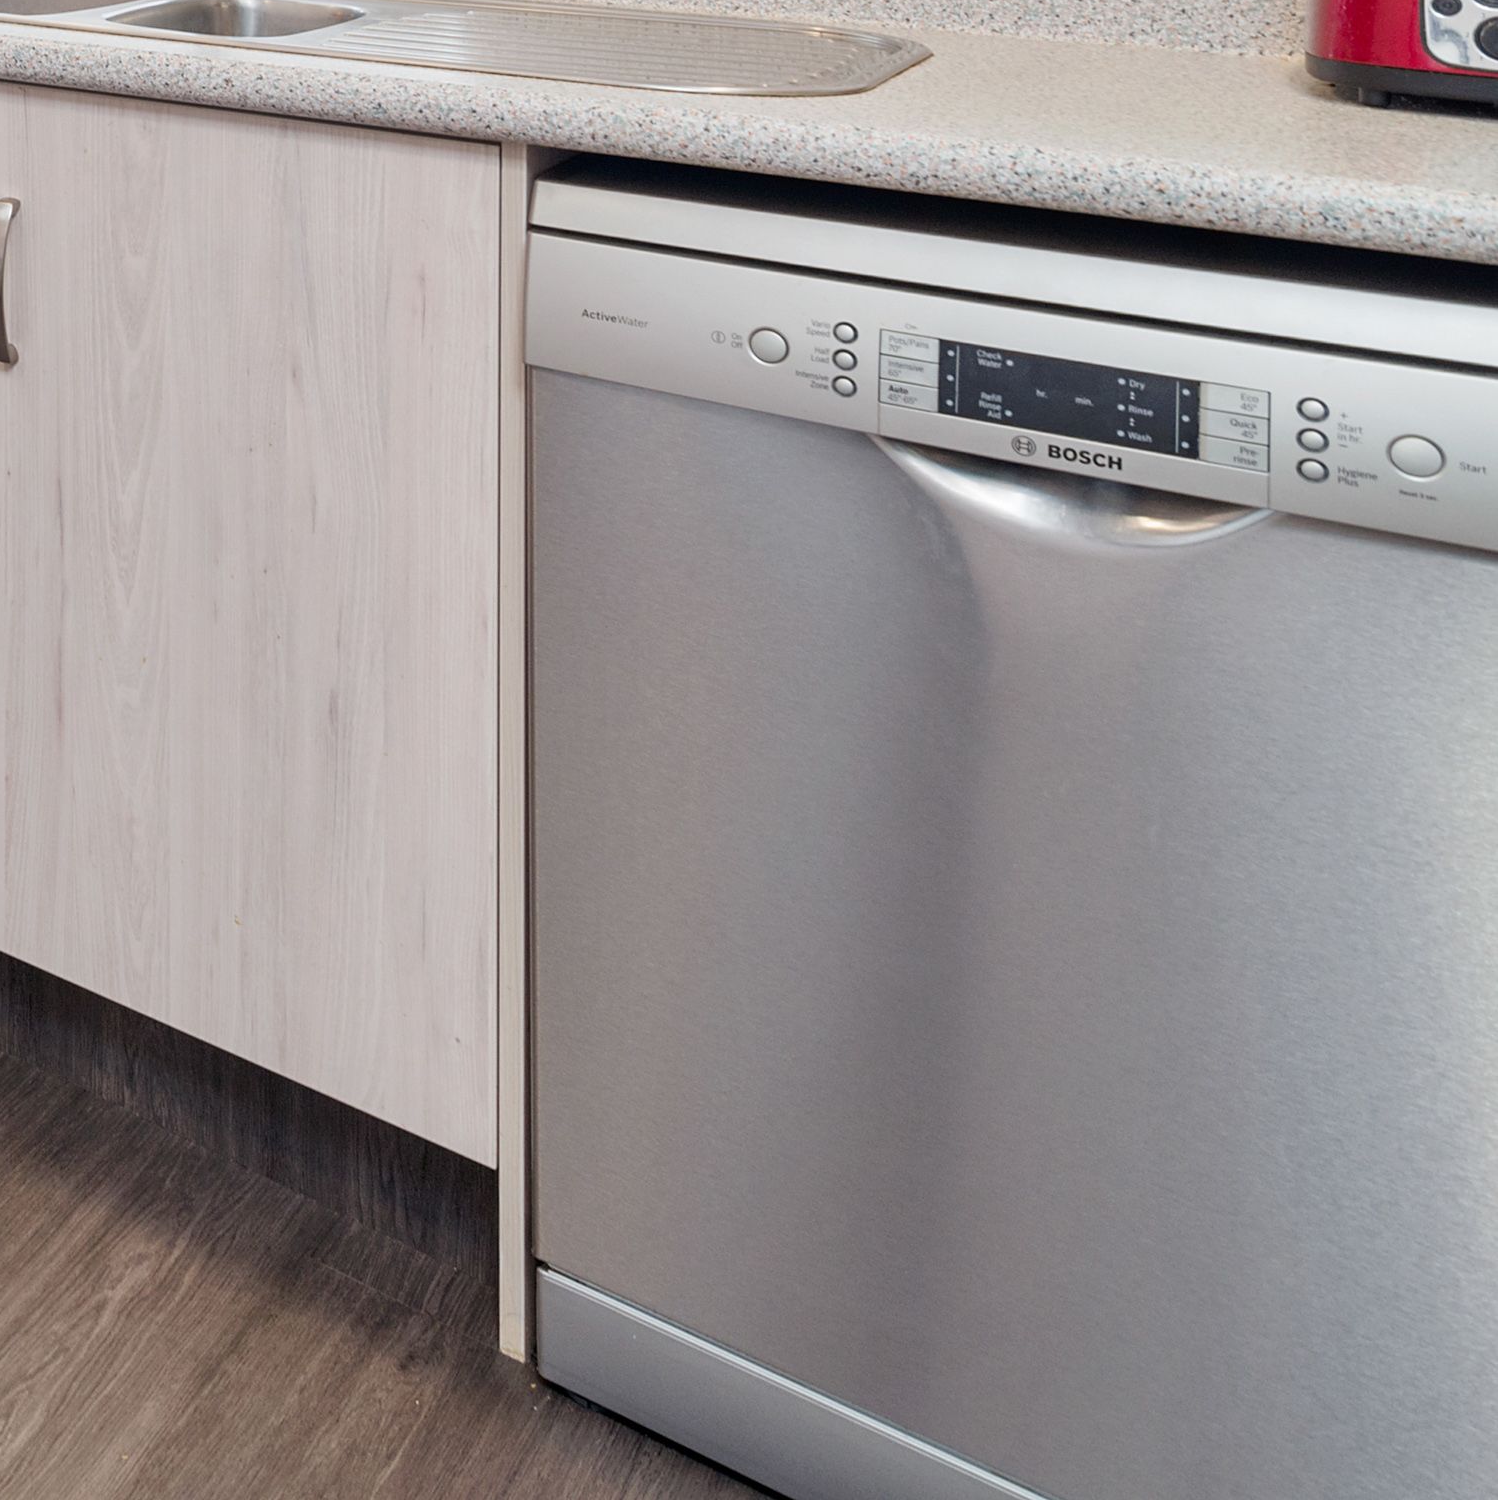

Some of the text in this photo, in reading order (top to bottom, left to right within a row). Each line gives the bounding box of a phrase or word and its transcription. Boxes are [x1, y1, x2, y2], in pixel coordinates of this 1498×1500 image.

[581, 308, 649, 329] ActiveWater
[731, 332, 742, 340] On
[976, 350, 1002, 361] Check
[978, 358, 1002, 369] Water
[889, 385, 908, 395] Auto
[1129, 379, 1145, 391] Dry
[980, 392, 1002, 403] Refill
[979, 400, 1002, 411] Rinse
[1128, 404, 1153, 417] Rinse
[987, 409, 1002, 420] Aid
[1229, 418, 1258, 430] Quick
[1337, 421, 1364, 435] Start
[1127, 430, 1153, 443] Wash
[1047, 444, 1123, 470] BOSCH
[1233, 455, 1258, 466] rinse
[1459, 461, 1487, 474] Start
[1337, 476, 1360, 488] Plus
